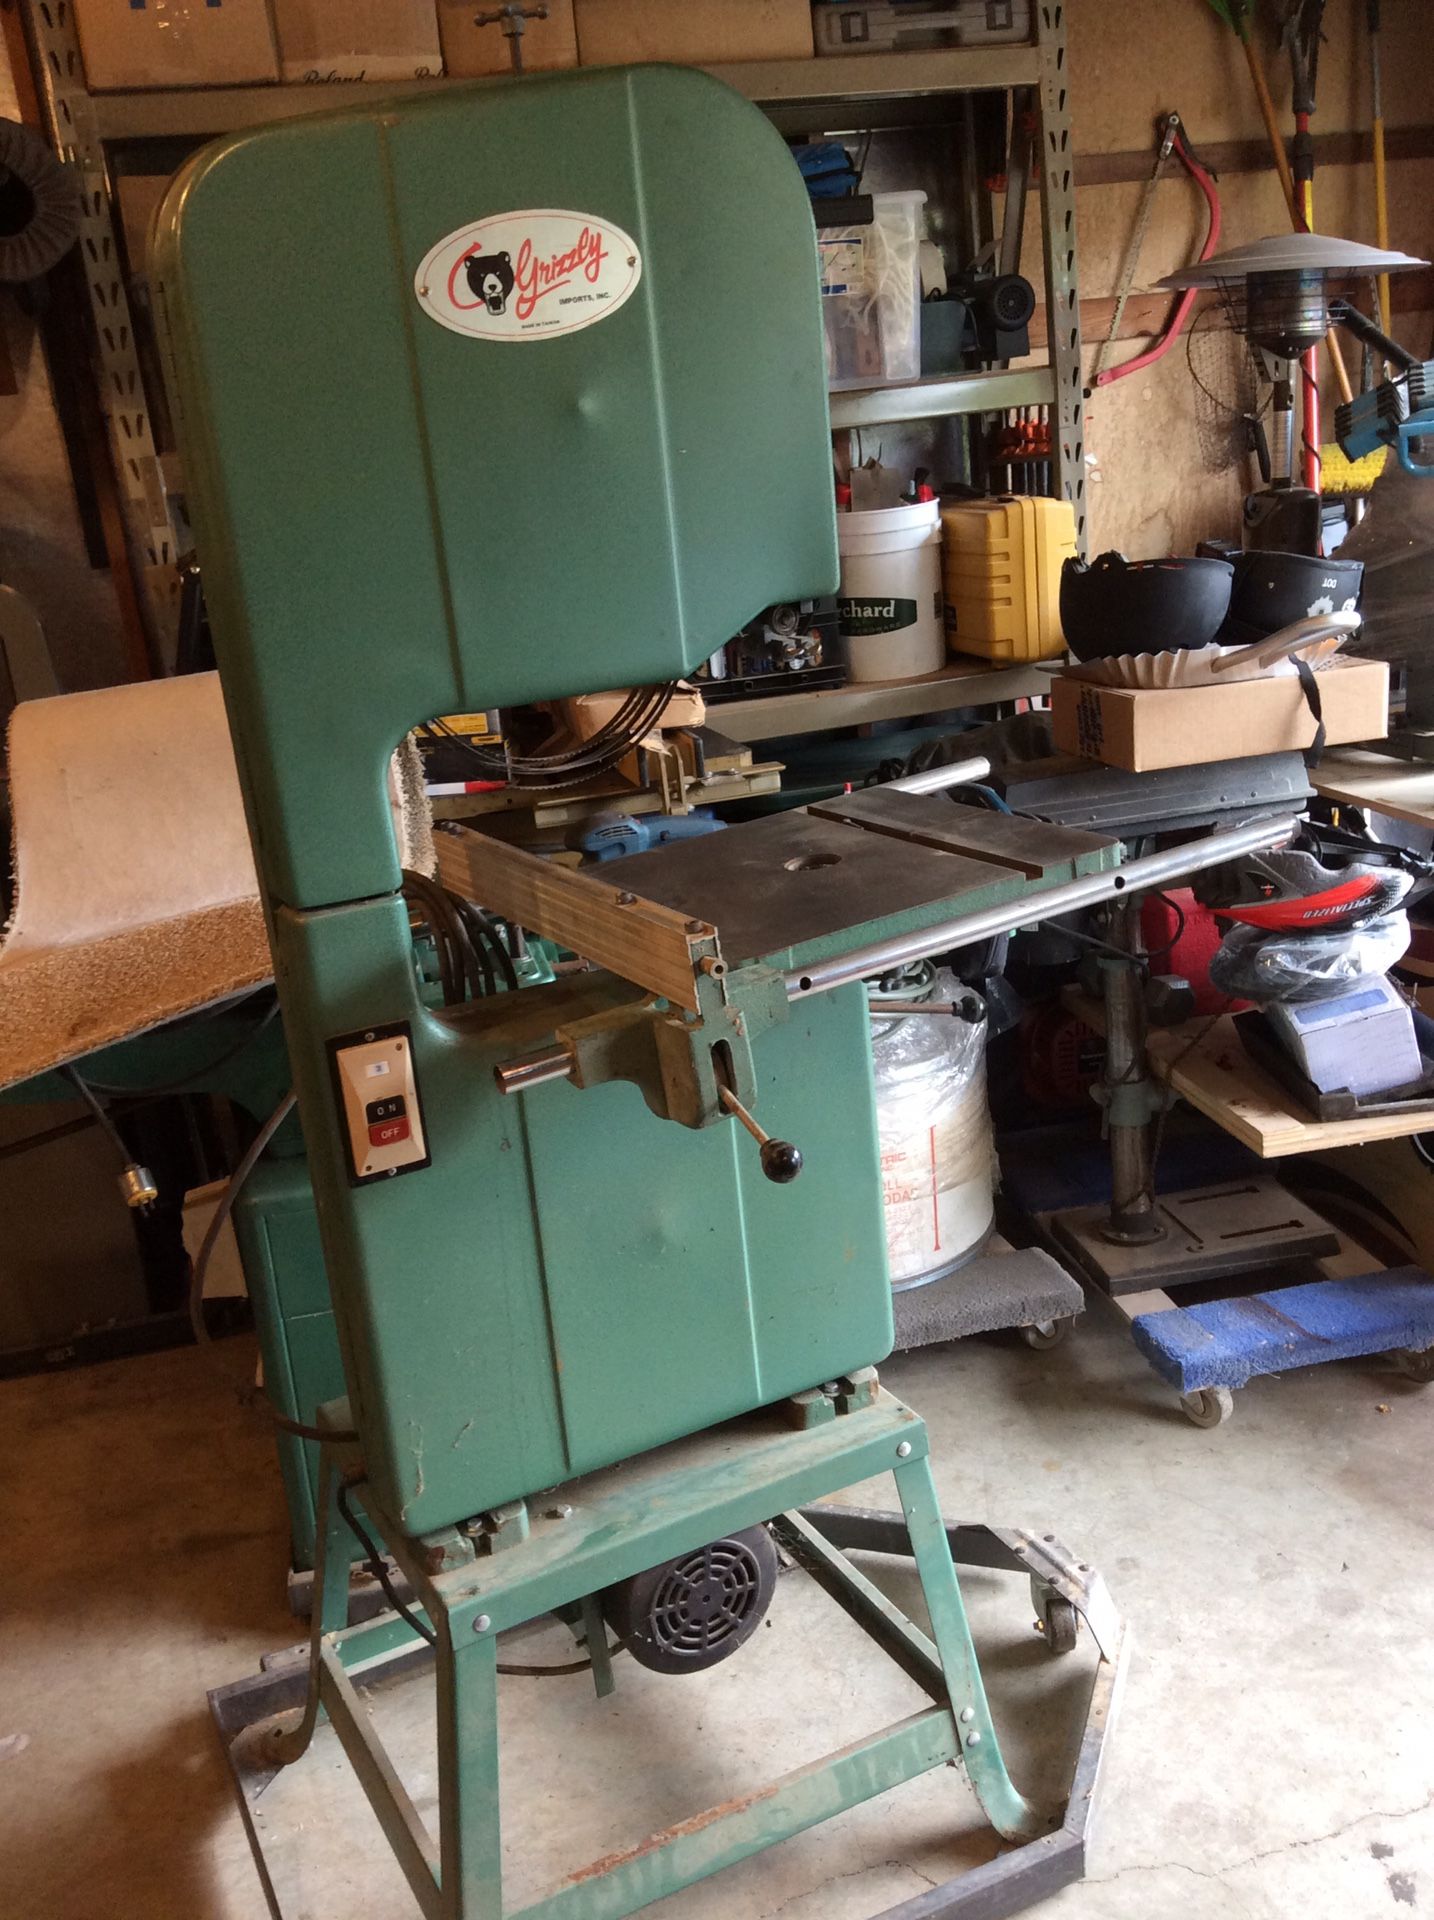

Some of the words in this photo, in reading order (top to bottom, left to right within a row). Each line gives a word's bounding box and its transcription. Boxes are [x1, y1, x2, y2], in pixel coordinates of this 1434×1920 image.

[304, 70, 366, 84] Roland
[513, 226, 608, 320] Grizzly
[559, 294, 594, 305] IMPORTS,
[1322, 577, 1337, 589] DOT
[1303, 895, 1375, 918] SPECIALIZED
[380, 1126, 400, 1140] OFF
